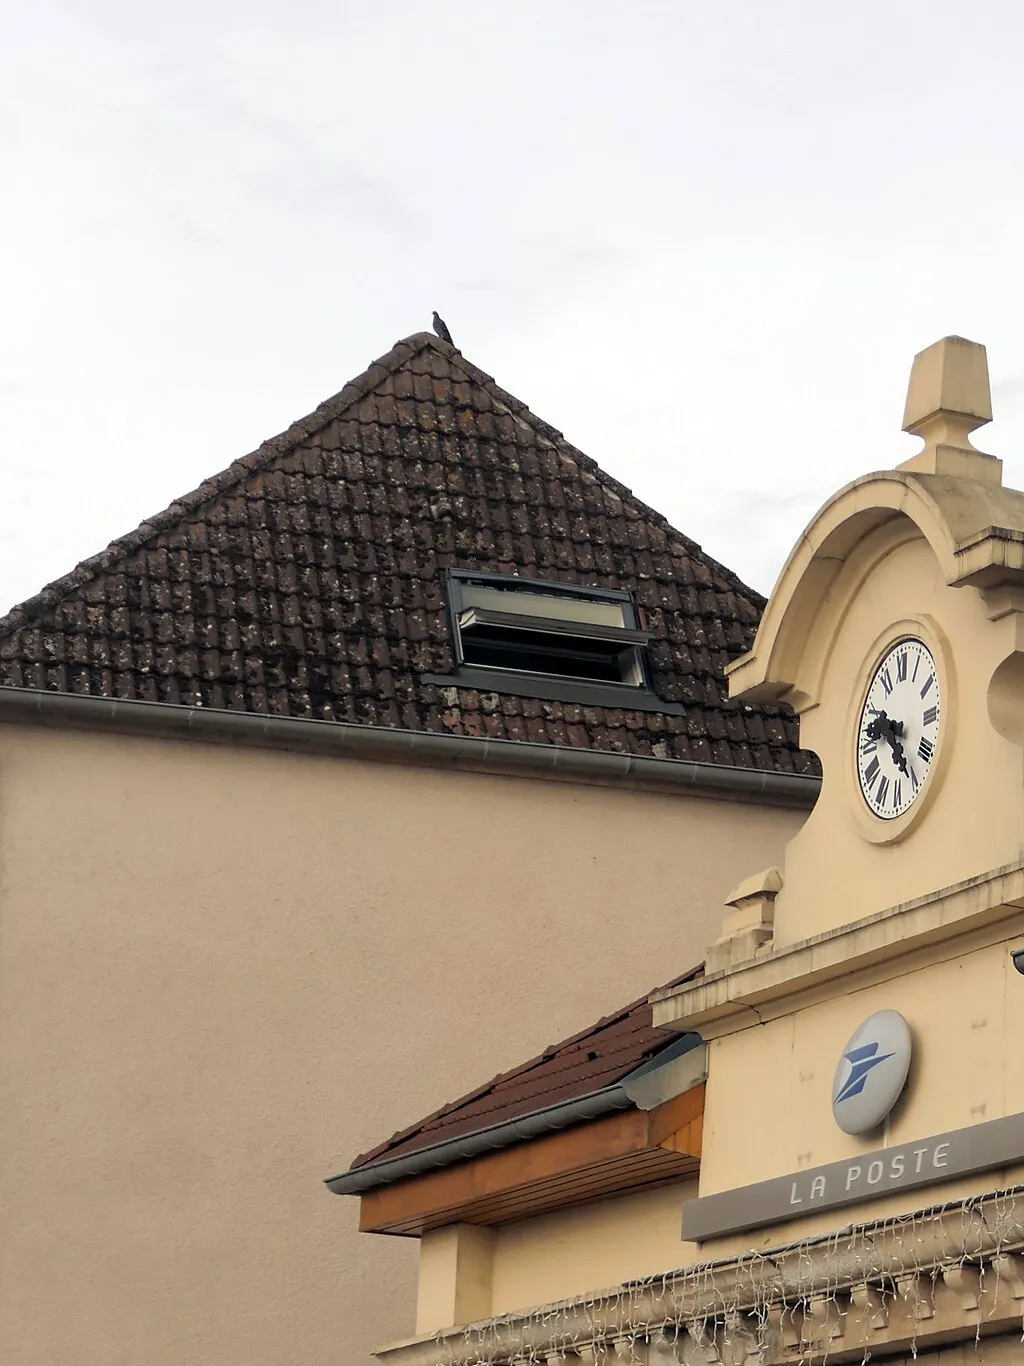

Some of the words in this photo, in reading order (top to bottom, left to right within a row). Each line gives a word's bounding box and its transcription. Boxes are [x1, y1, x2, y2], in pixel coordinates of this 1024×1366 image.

[923, 705, 937, 727] III
[789, 1175, 826, 1205] LA
[845, 1142, 951, 1191] POSTE
